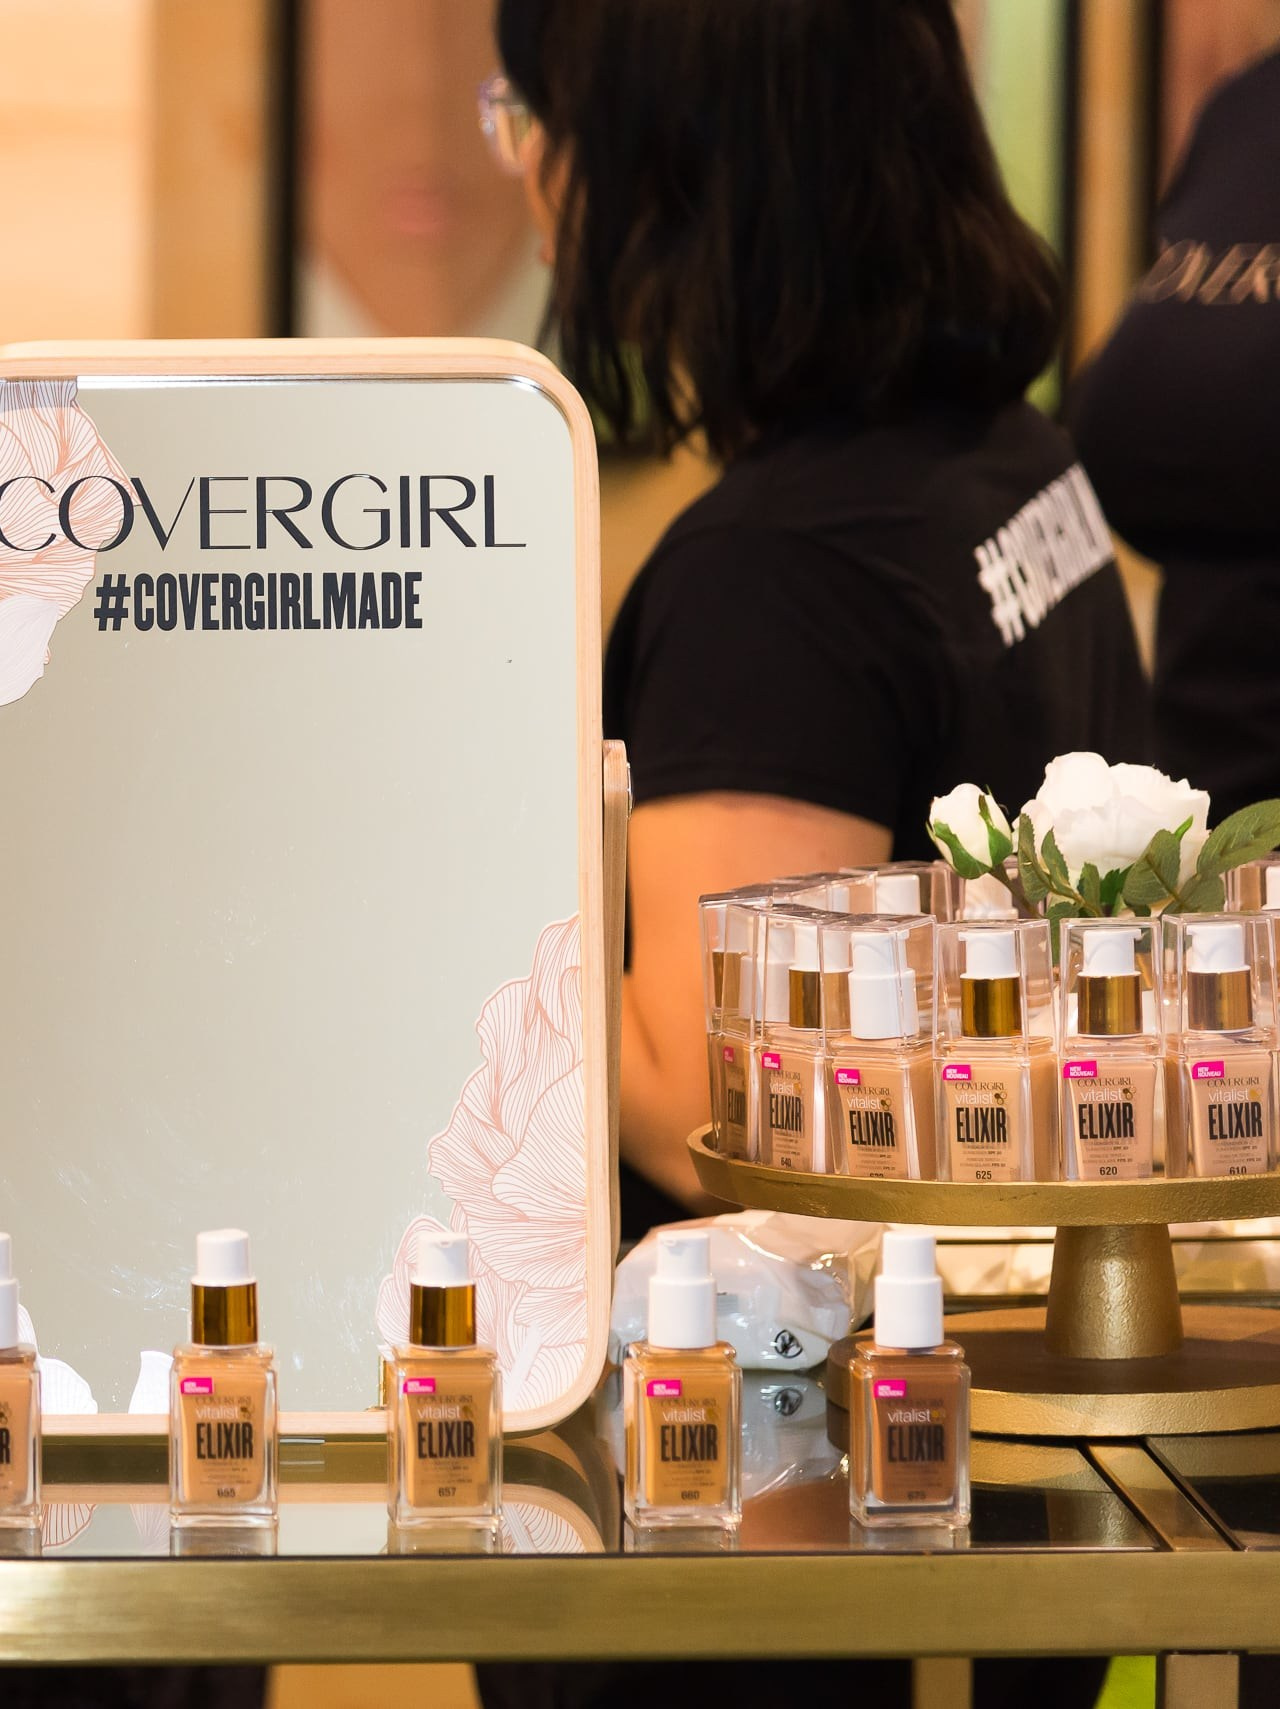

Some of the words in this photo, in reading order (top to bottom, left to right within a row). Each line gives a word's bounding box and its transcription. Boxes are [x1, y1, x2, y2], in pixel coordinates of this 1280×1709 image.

[93, 570, 423, 631] #COVERGIRLMADE
[770, 1082, 794, 1095] vitalist
[955, 1082, 1005, 1091] COVERGIRL
[1077, 1078, 1133, 1087] COVERGIRL
[1207, 1077, 1259, 1087] COVERGIRL
[847, 1087, 890, 1095] COVERGIRL
[1080, 1088, 1122, 1101] vitalist
[1208, 1088, 1249, 1102] vitalist
[847, 1096, 881, 1109] vitalist
[955, 1092, 994, 1105] vitalist
[770, 1094, 801, 1133] ELIXIR
[956, 1107, 1007, 1143] ELIXIR
[1078, 1102, 1134, 1140] ELIXIR
[1208, 1101, 1263, 1140] ELIXIR
[849, 1110, 895, 1147] ELIXIR
[781, 1157, 792, 1168] 640
[975, 1171, 992, 1180] 625
[1099, 1167, 1118, 1176] 620
[196, 1406, 239, 1419] vitalist
[417, 1406, 460, 1419] vitalist
[663, 1408, 706, 1422] vitalist
[888, 1409, 930, 1422] vitalist
[197, 1422, 253, 1459] ELIXIR
[418, 1421, 474, 1459] ELIXIR
[661, 1424, 717, 1462] ELIXIR
[888, 1424, 944, 1462] ELIXIR
